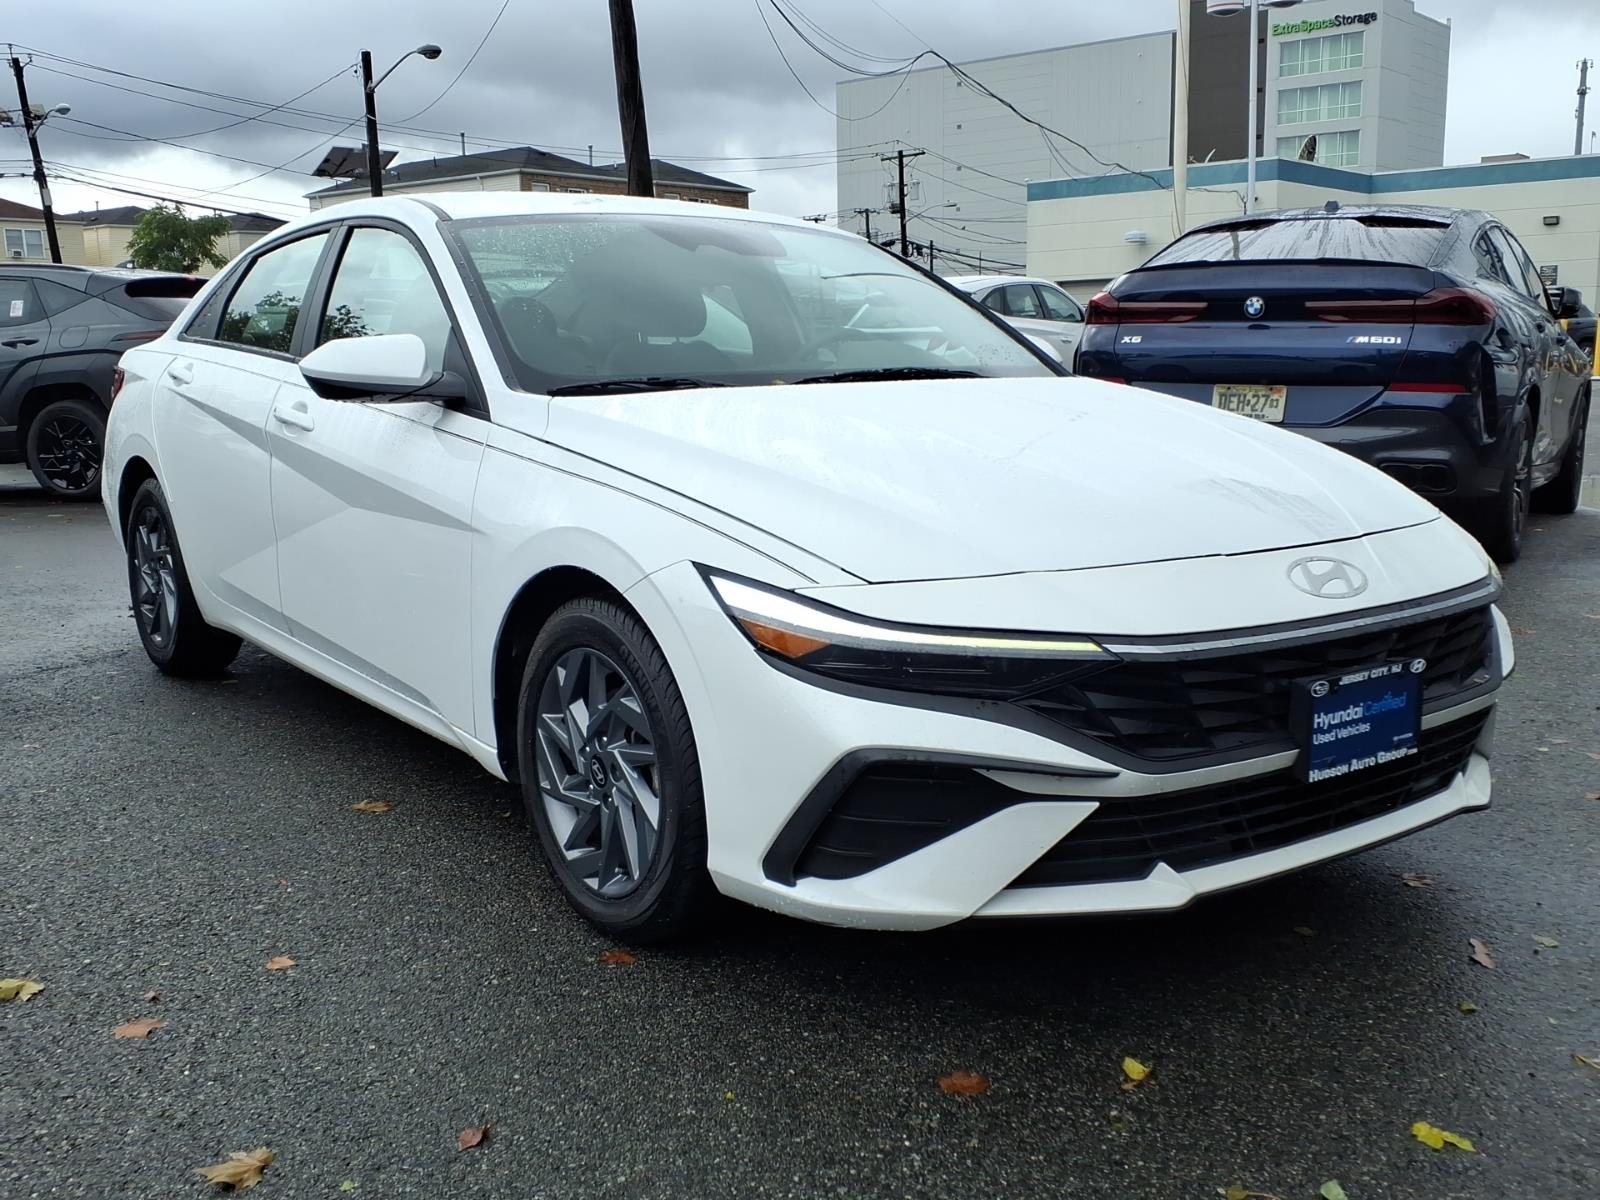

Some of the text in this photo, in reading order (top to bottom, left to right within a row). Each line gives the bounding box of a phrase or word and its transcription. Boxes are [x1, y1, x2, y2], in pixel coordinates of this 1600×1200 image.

[1121, 335, 1142, 343] X6
[1339, 671, 1369, 685] JERSEY
[1391, 663, 1402, 674] NJ
[1313, 691, 1407, 730] Hyundai Certified
[1313, 722, 1371, 745] Used Vehicles
[1309, 763, 1349, 783] HUDSON
[1350, 756, 1376, 772] AUTO
